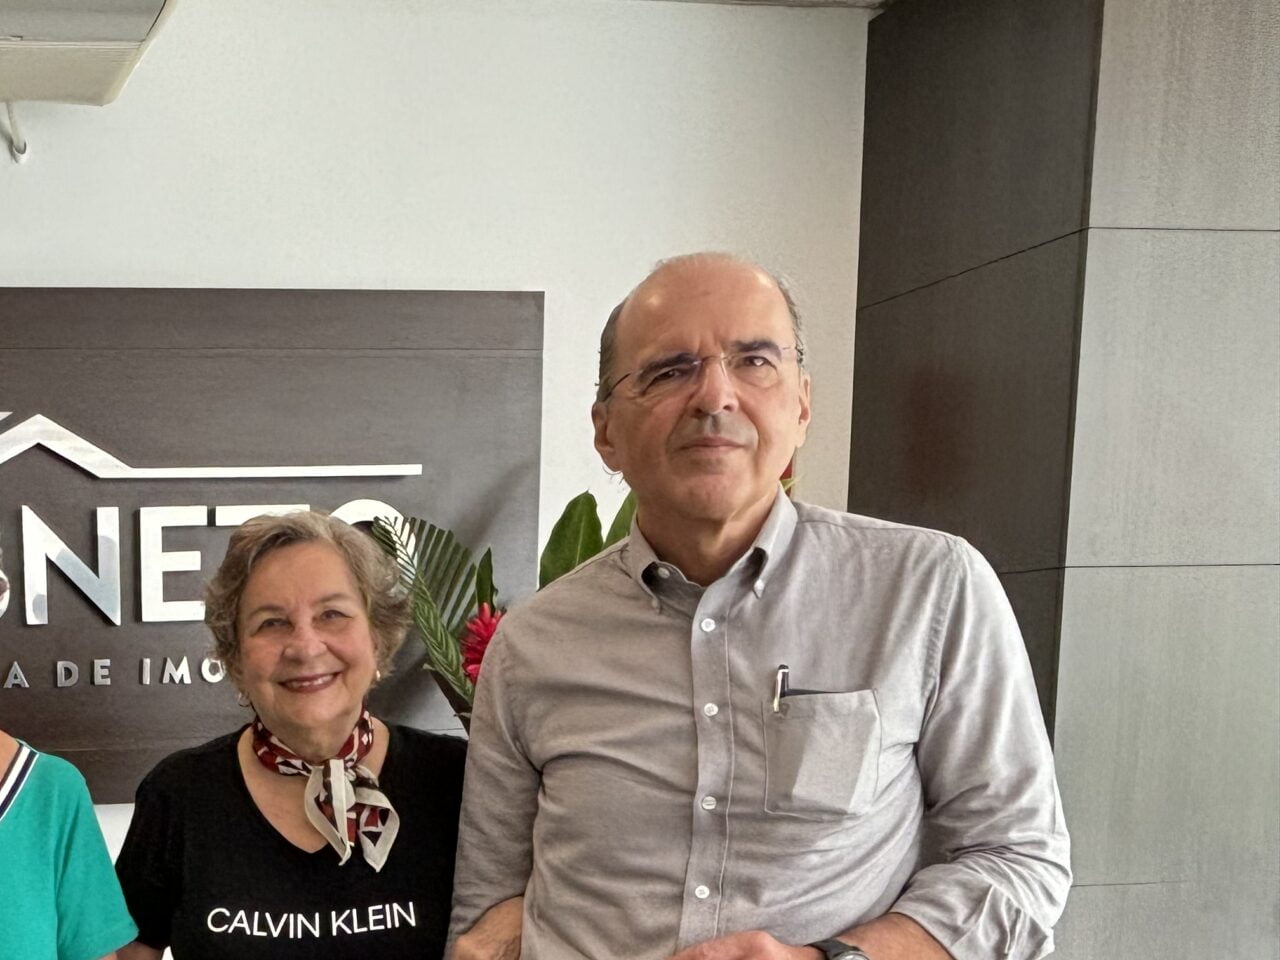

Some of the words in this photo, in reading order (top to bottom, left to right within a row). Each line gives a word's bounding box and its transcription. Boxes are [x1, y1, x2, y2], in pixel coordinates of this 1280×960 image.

[56, 658, 112, 688] DE
[206, 907, 320, 939] CALVIN
[331, 901, 416, 937] KLEIN
